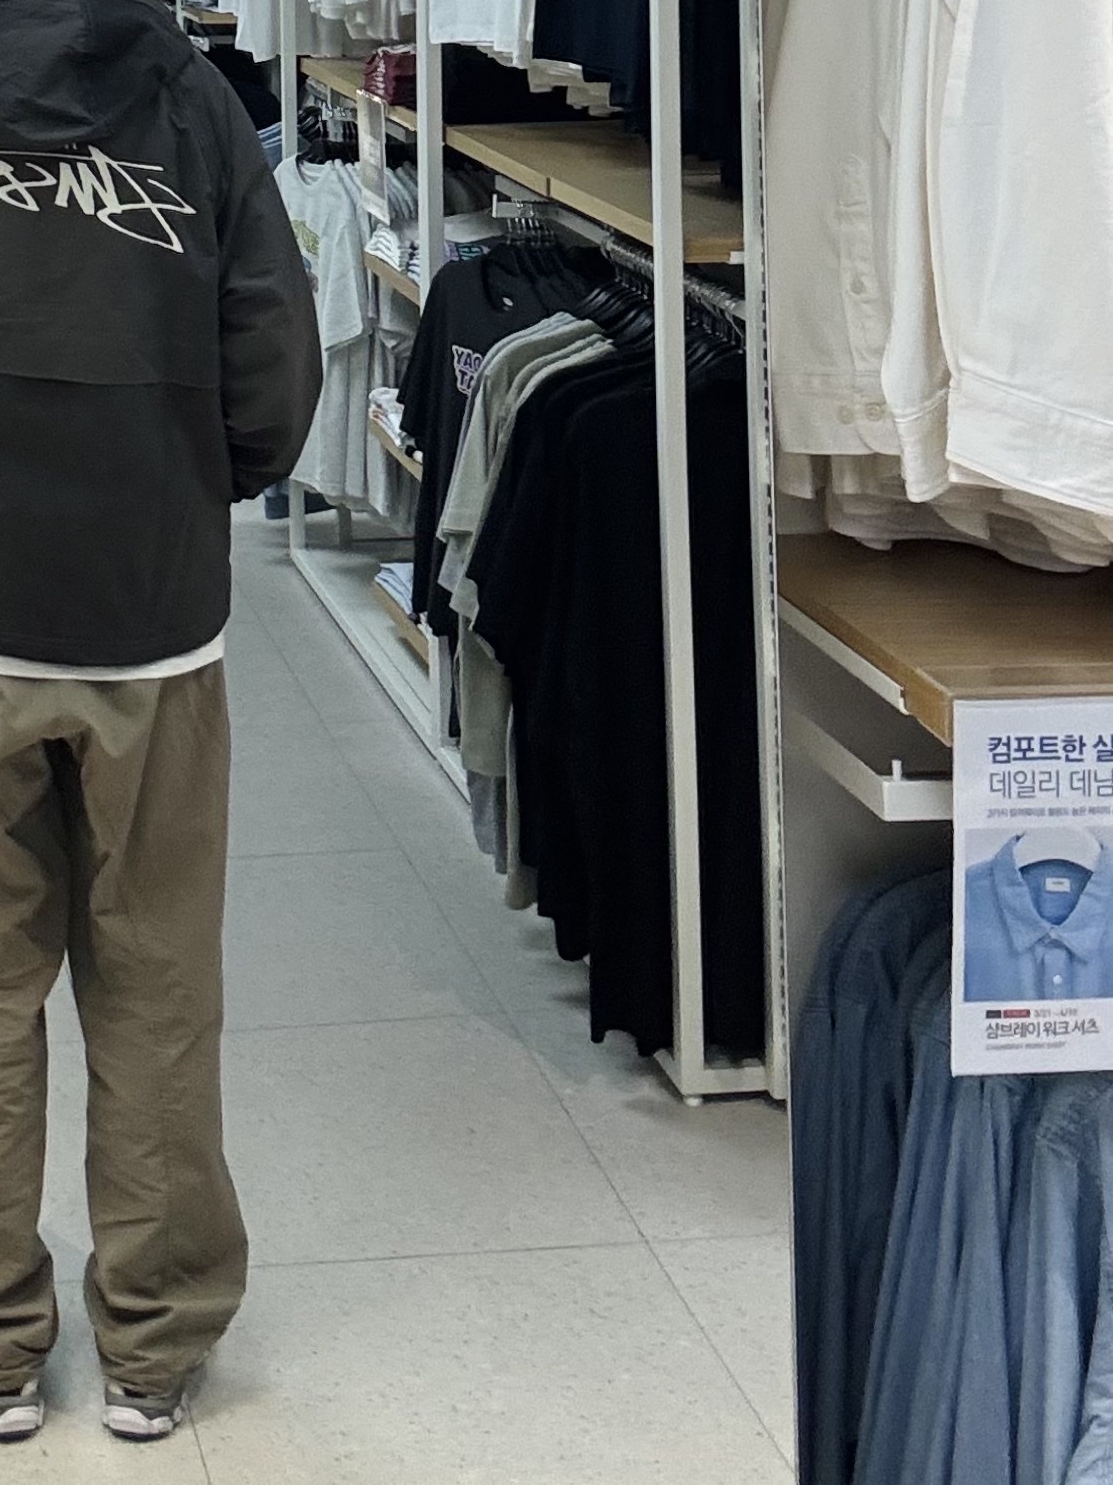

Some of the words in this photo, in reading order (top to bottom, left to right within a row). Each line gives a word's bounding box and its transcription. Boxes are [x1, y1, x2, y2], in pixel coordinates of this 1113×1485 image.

[987, 734, 1087, 765] 컴포트한
[989, 769, 1060, 799] 데일리
[1043, 1020, 1071, 1037] 워크
